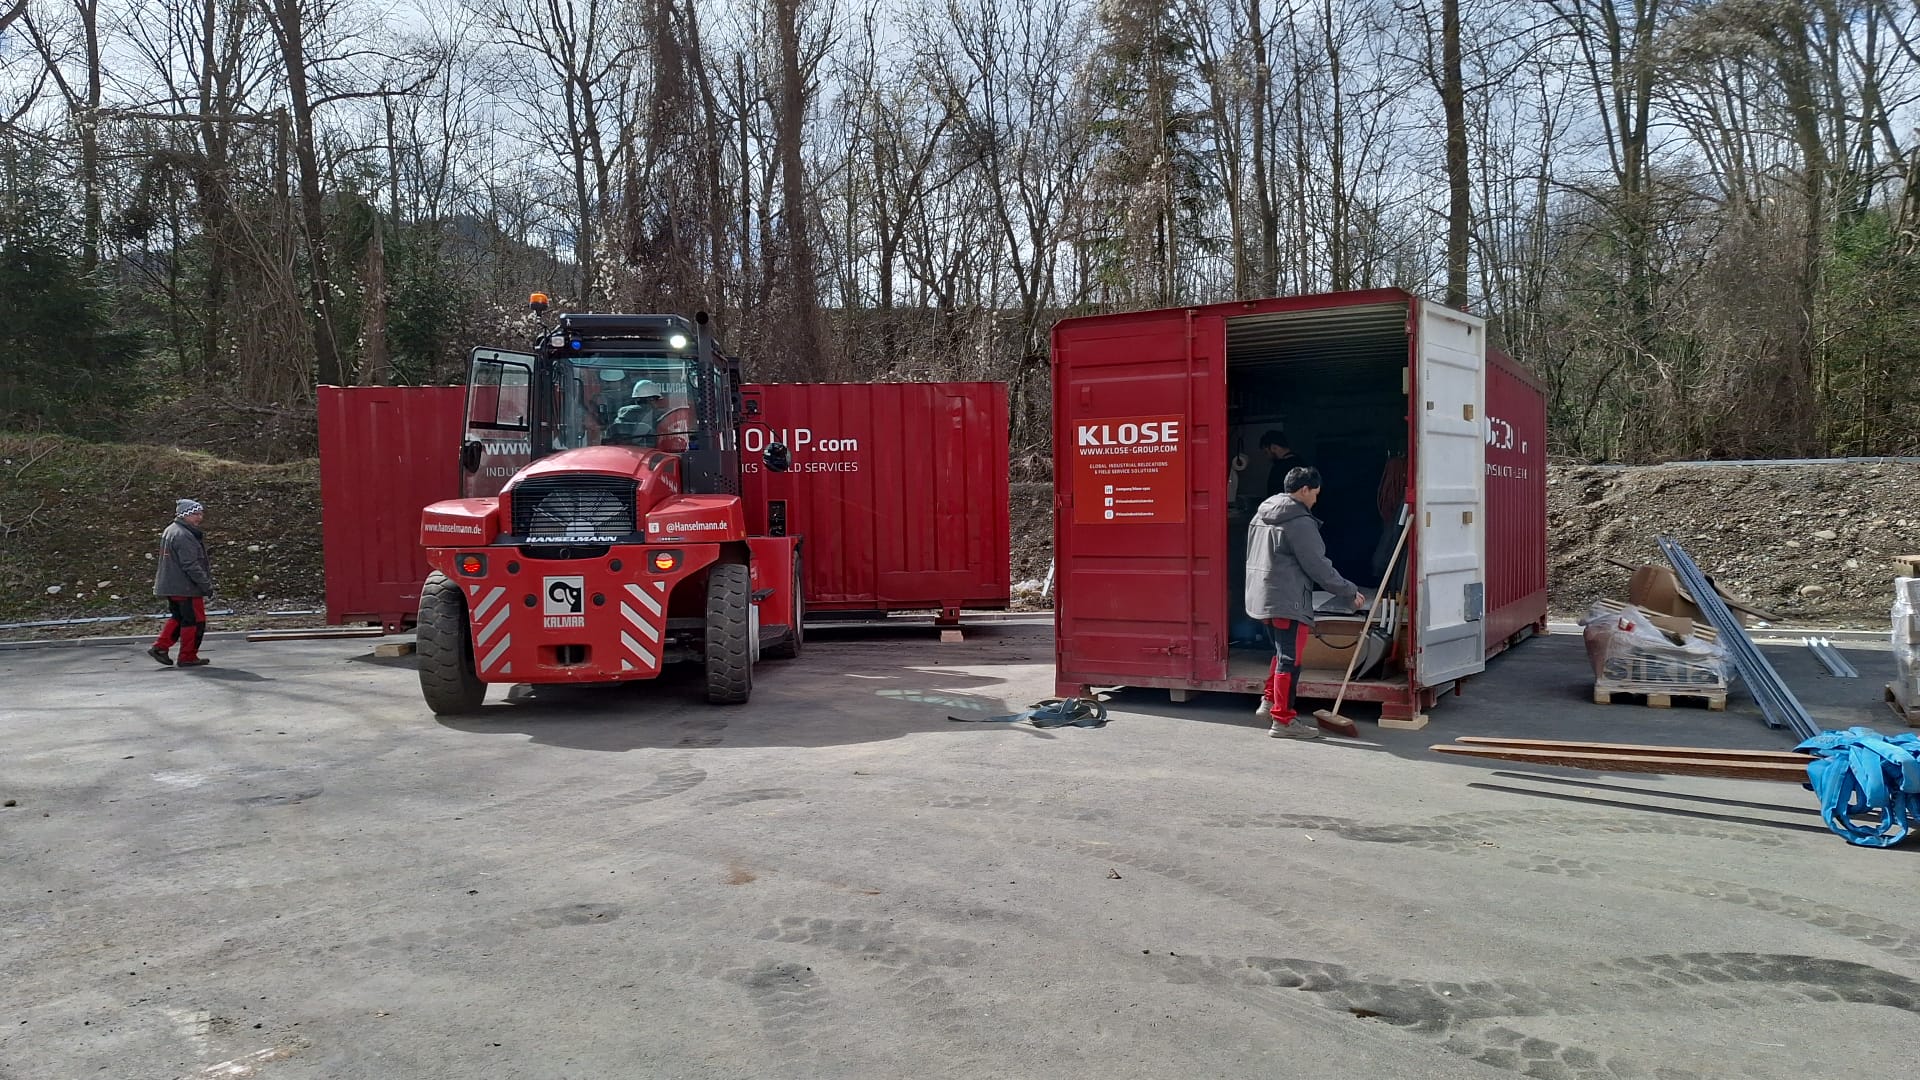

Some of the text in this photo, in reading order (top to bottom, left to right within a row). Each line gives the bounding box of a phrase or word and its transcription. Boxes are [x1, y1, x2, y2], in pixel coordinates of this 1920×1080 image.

[1078, 421, 1179, 446] KLOSE
[1079, 445, 1178, 456] WWW.KLOSE-GROUP.COM
[805, 462, 858, 473] SERVICES
[424, 522, 482, 535] www.hanselmann.de
[666, 521, 728, 532] @Hanselmann.de
[543, 616, 585, 628] KALMAR
